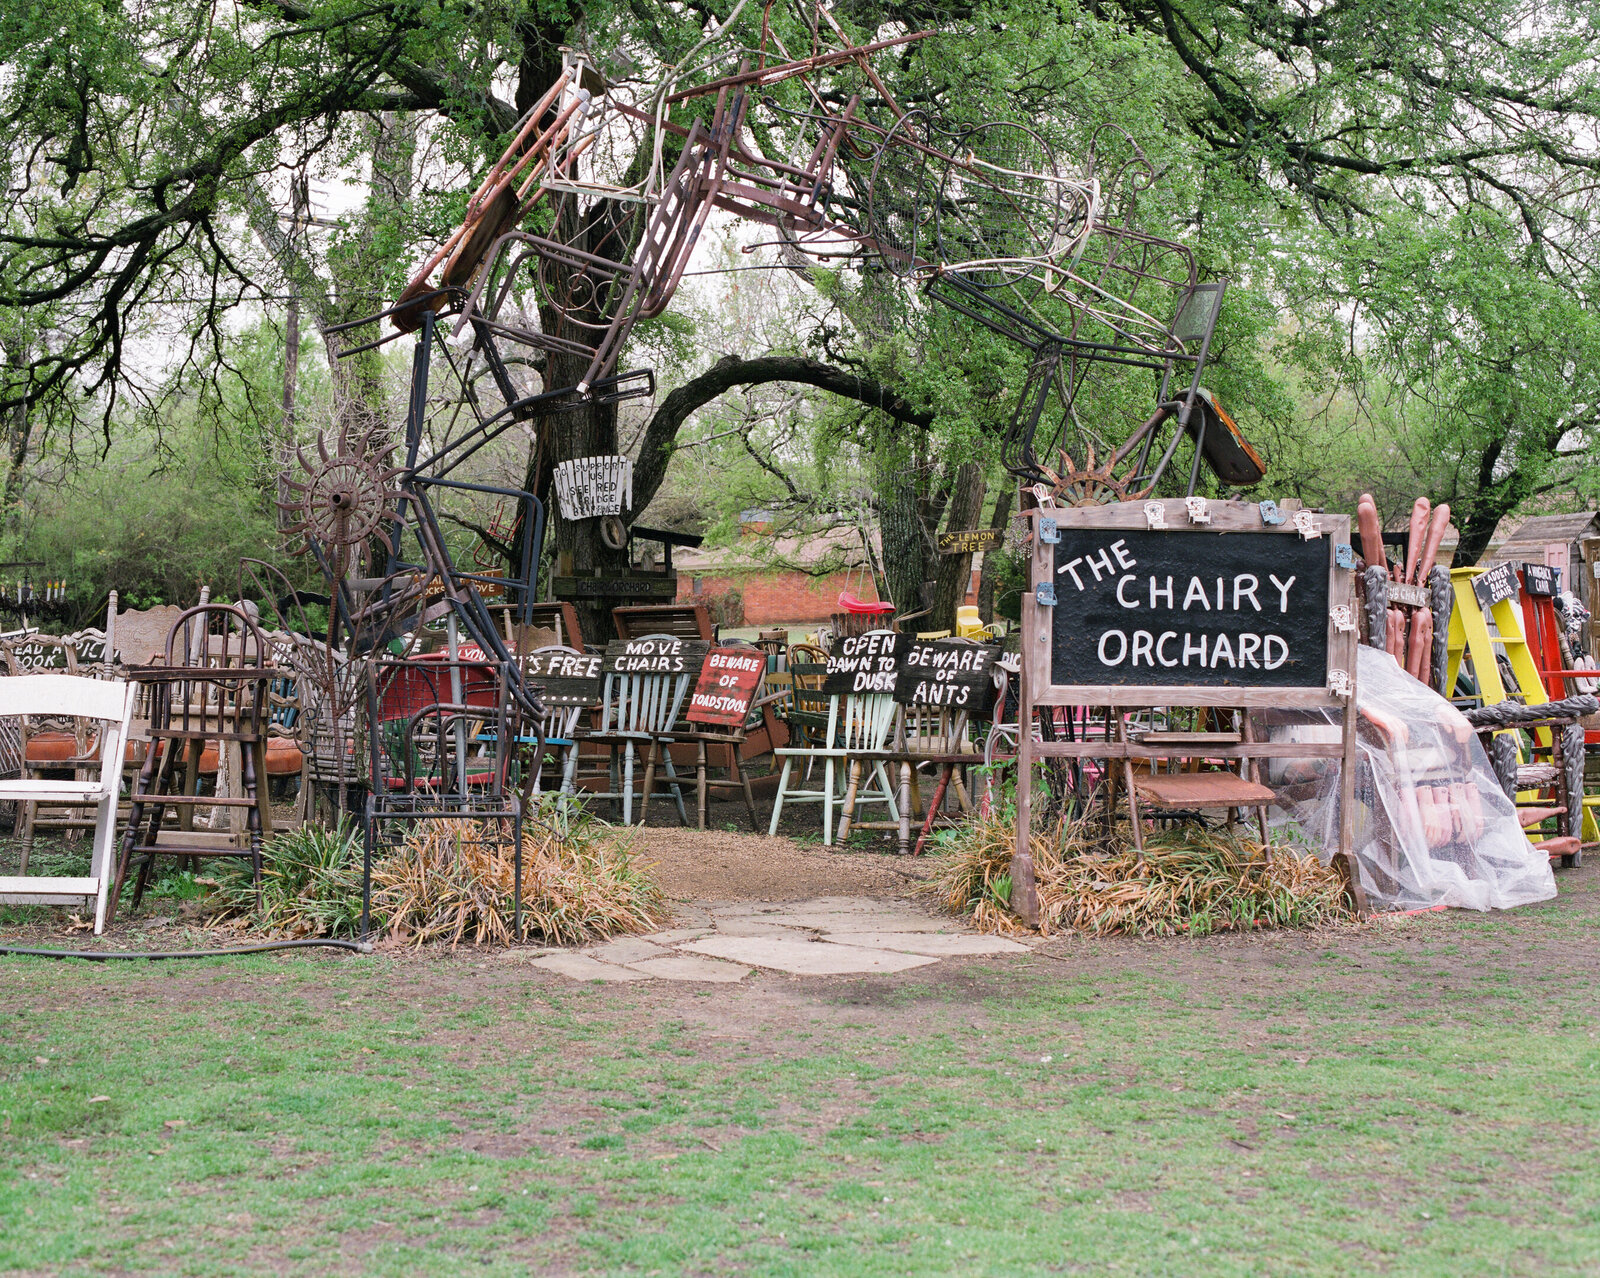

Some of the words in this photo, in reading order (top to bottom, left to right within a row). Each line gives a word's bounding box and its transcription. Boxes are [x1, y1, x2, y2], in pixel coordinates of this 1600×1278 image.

[554, 468, 566, 478] TO
[576, 462, 624, 472] SUPPORT
[590, 472, 602, 480] US
[570, 484, 588, 496] SEE
[597, 482, 616, 492] RED
[940, 534, 954, 546] THE
[959, 532, 994, 541] LEMON
[952, 542, 984, 552] TREE
[1057, 539, 1137, 591] THE
[1483, 566, 1510, 585] LADDER
[1116, 574, 1296, 613] CHAIRY
[1490, 578, 1508, 593] BACK
[1492, 586, 1514, 602] CHAIR
[625, 641, 682, 656] MOVE
[843, 635, 896, 656] OPEN
[1098, 630, 1289, 670] ORCHARD
[548, 656, 602, 678] FREE
[614, 656, 684, 672] CHAIRS
[710, 654, 760, 672] BEWARE
[826, 656, 872, 674] DAWN
[878, 656, 895, 672] TO
[908, 645, 988, 671] BEWARE
[719, 675, 738, 688] OF
[853, 672, 898, 692] DUSK
[936, 670, 957, 683] OF
[913, 681, 970, 705] ANTS
[691, 694, 748, 714] TOADSTOOL
